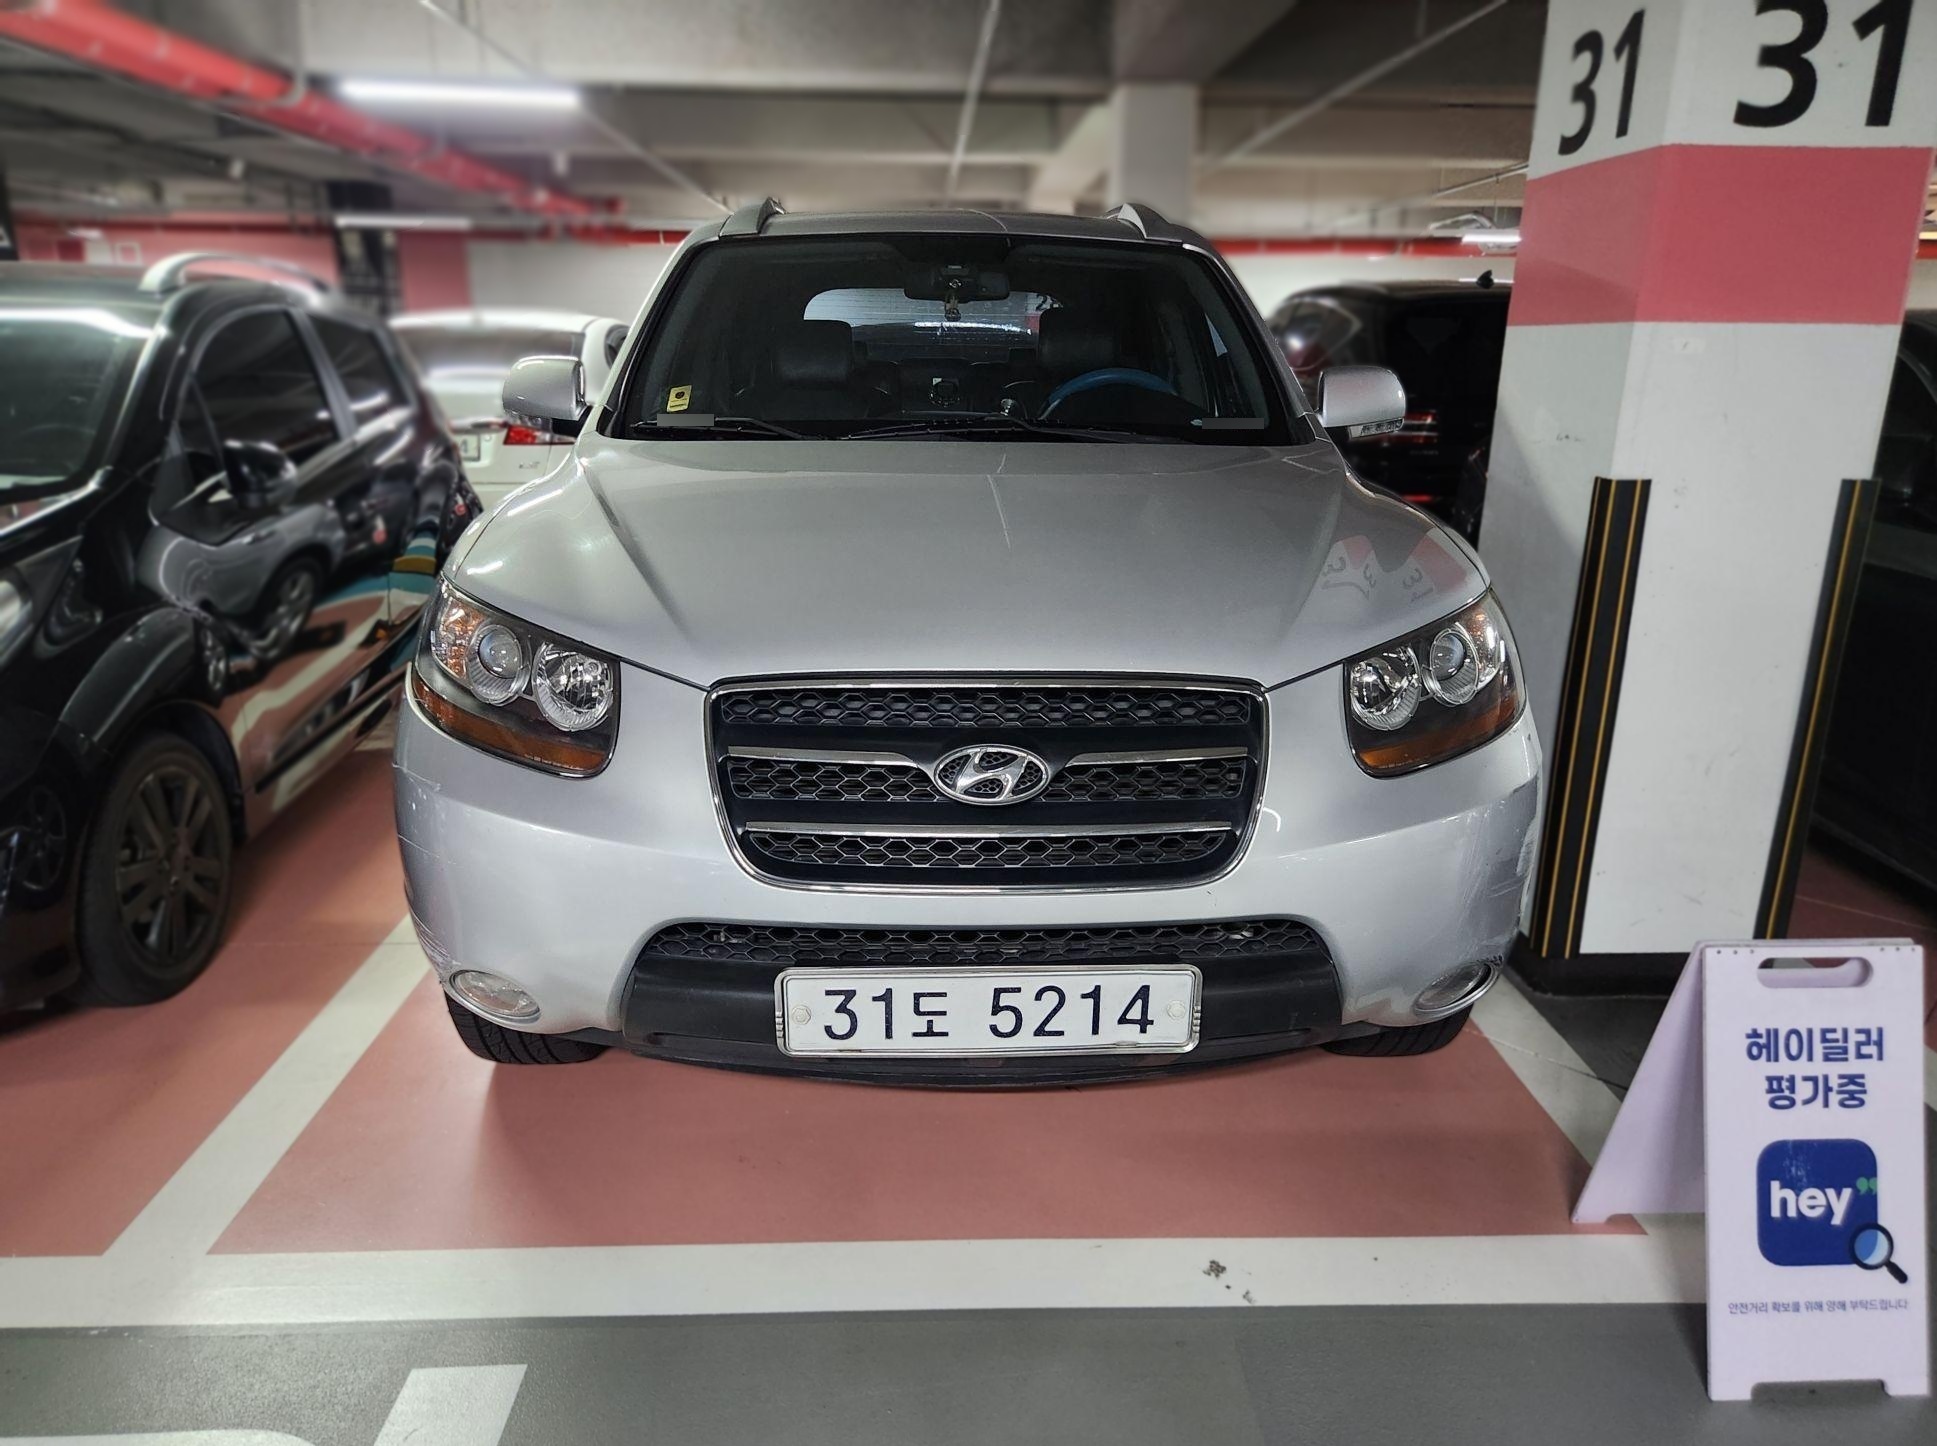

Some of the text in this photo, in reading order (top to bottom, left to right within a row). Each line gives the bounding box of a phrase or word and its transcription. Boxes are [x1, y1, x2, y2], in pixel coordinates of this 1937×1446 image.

[1557, 8, 1646, 156] 31
[1733, 0, 1915, 128] 31
[823, 984, 1155, 1041] 31도 5214
[1745, 1026, 1884, 1063] 헤이딜러
[1765, 1073, 1868, 1110] 평가중
[1727, 1298, 1909, 1315] 안전거리 확보를 위해 양해 부탁드립니다
